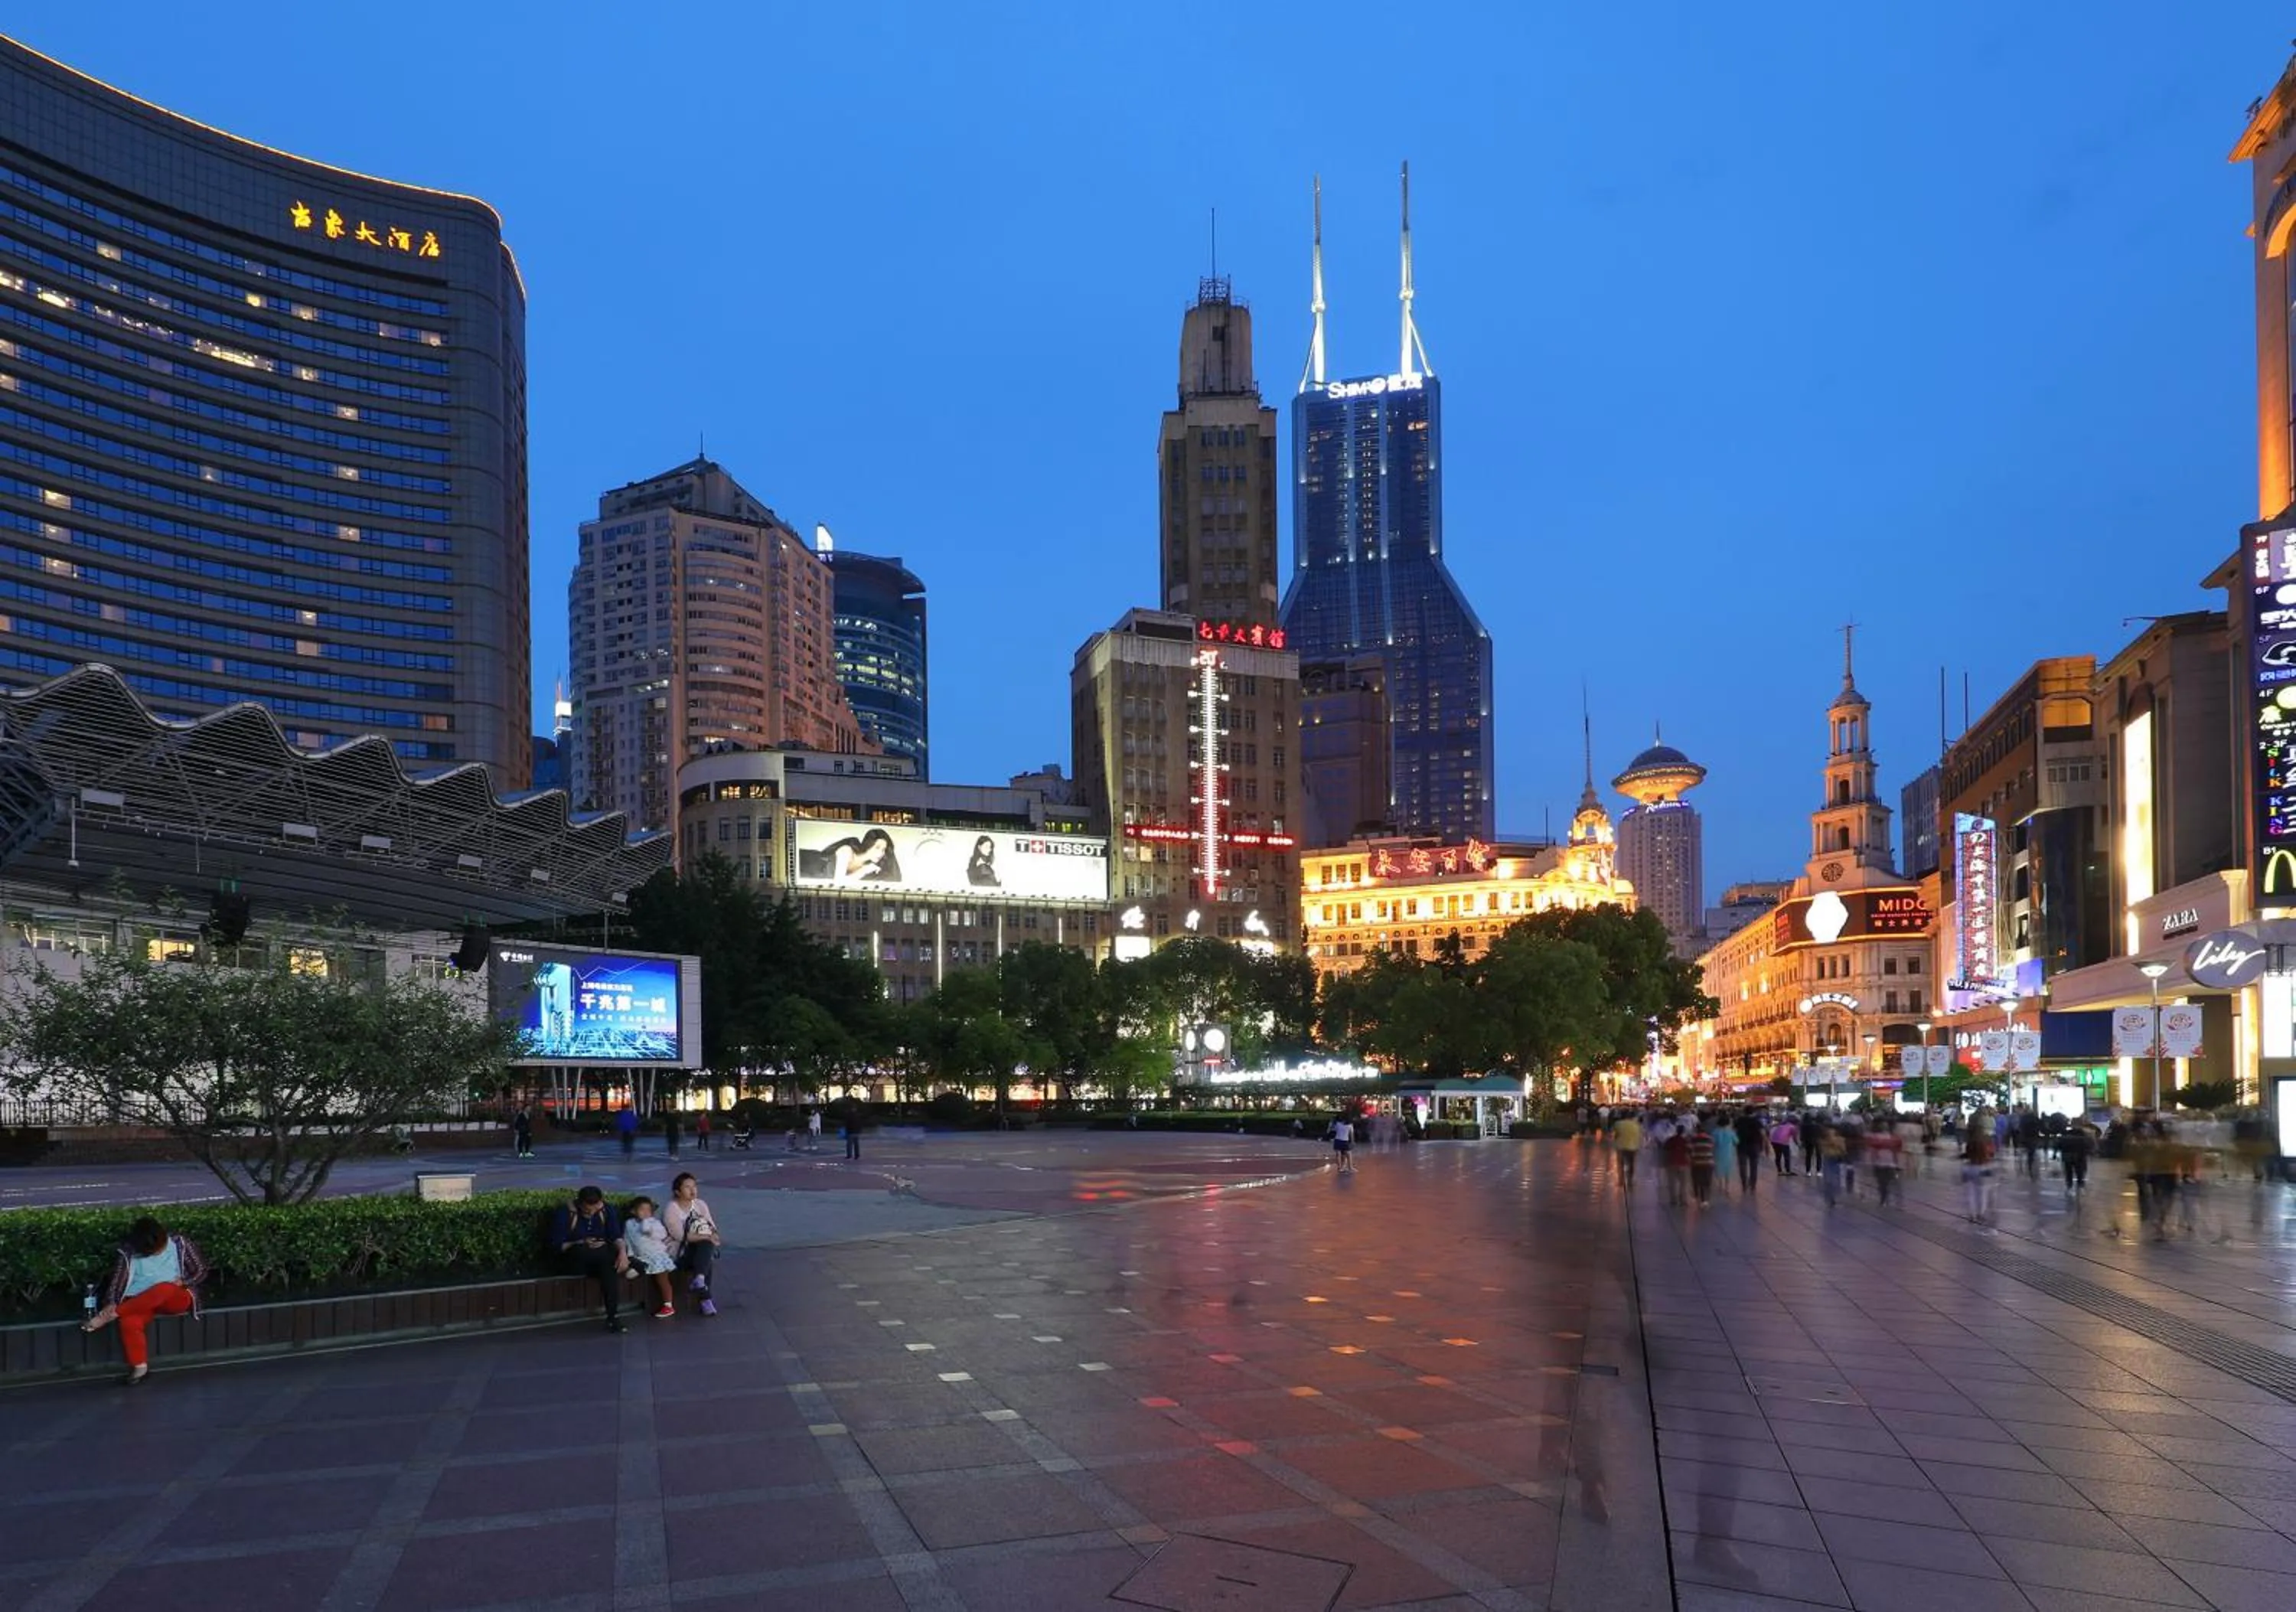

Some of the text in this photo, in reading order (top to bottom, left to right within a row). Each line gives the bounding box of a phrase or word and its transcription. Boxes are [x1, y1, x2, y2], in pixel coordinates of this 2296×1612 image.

[2258, 689, 2274, 697] 4F
[2269, 796, 2283, 834] KING
[1047, 843, 1104, 857] TISSOT
[2263, 847, 2277, 855] B1
[2162, 908, 2199, 931] ZARA
[2193, 941, 2265, 975] Lily
